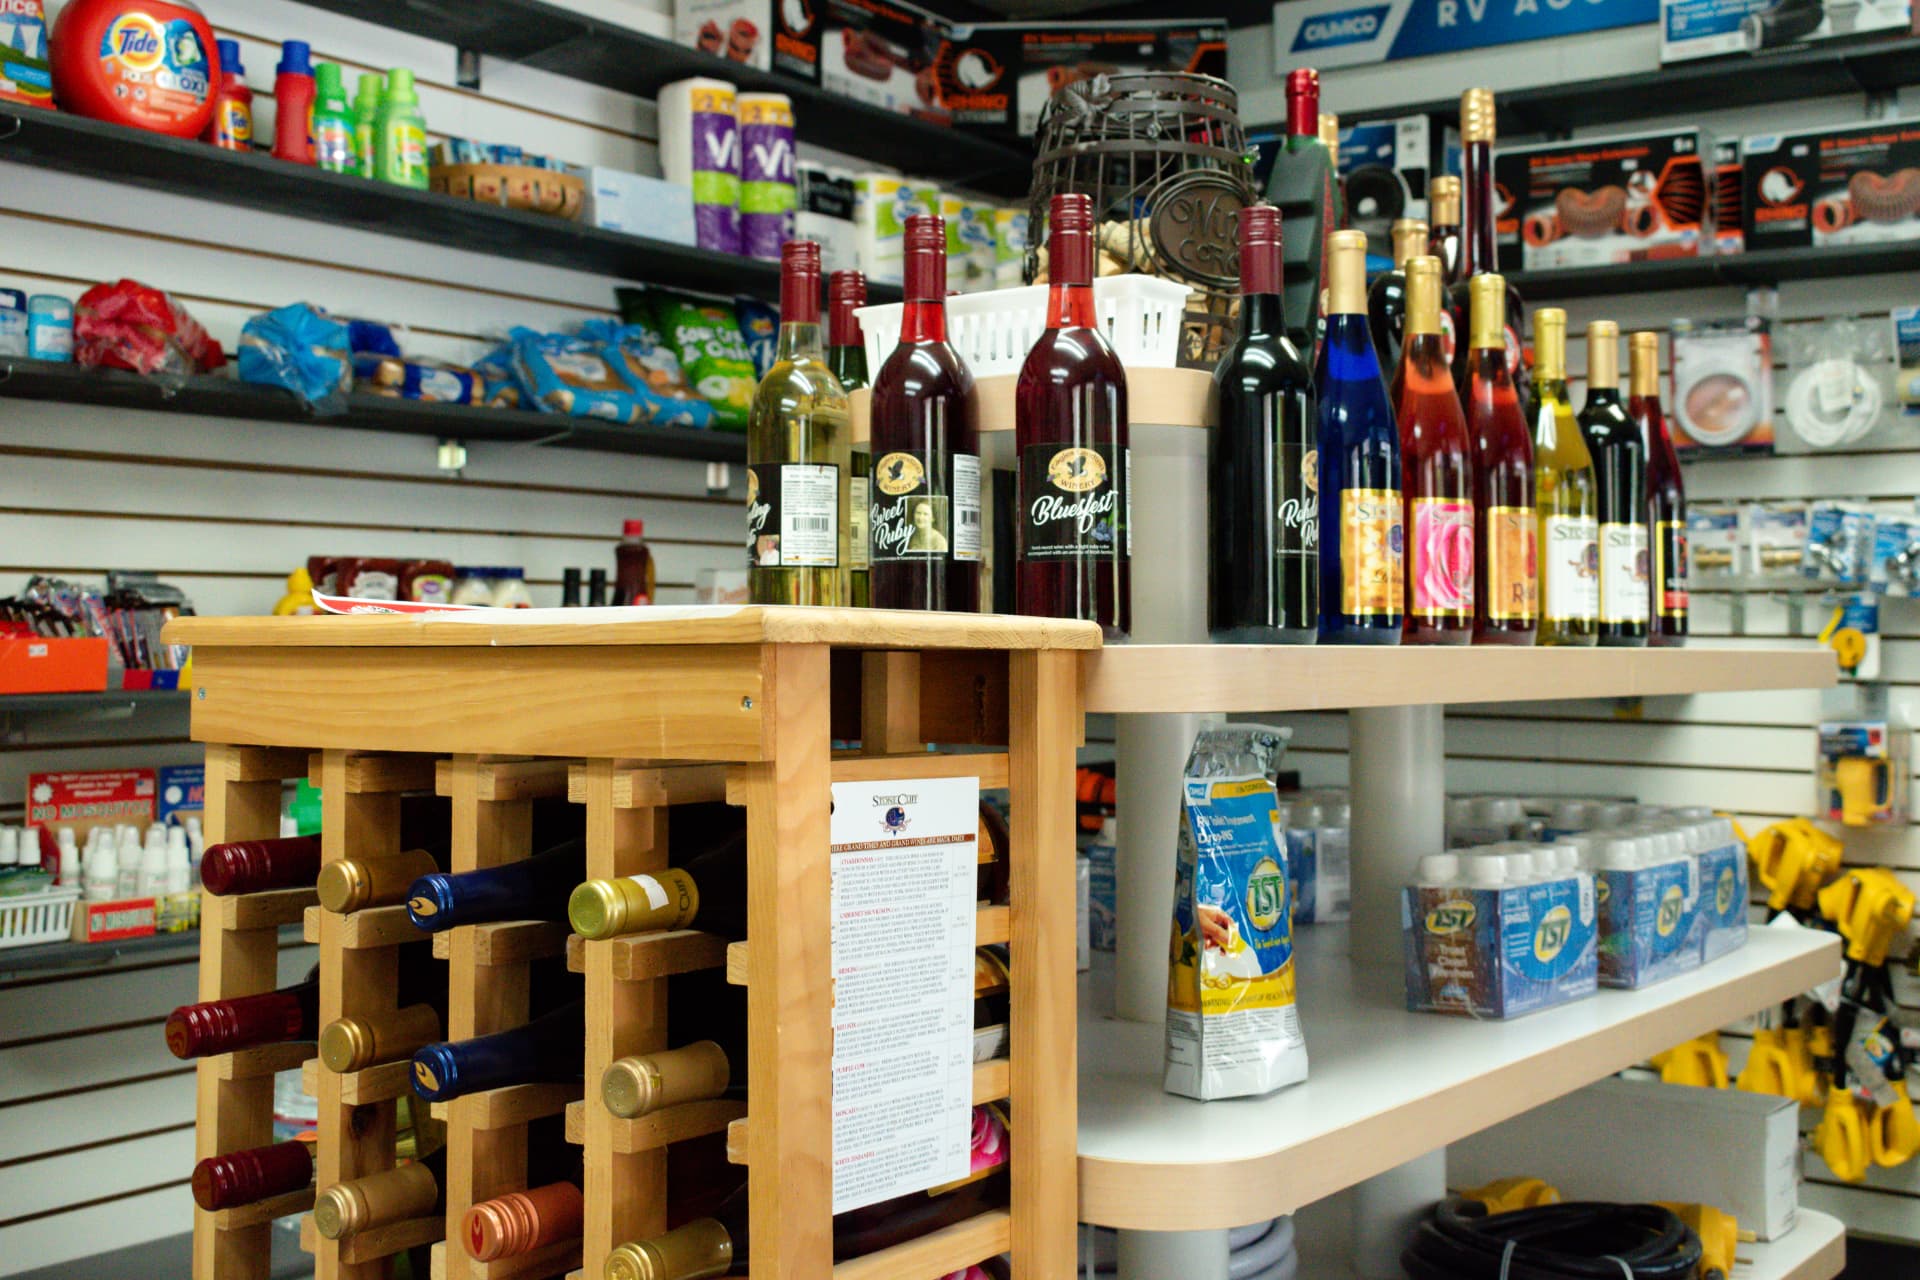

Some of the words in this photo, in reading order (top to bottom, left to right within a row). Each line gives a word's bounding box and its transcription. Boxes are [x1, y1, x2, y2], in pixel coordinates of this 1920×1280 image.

[119, 29, 158, 55] Tide
[1061, 479, 1095, 490] WINERY
[870, 496, 907, 530] Sweet
[1031, 489, 1119, 534] Bluesfest
[875, 518, 916, 556] Ruby
[32, 806, 56, 820] NO
[1250, 875, 1283, 917] TST
[1541, 917, 1570, 952] TST
